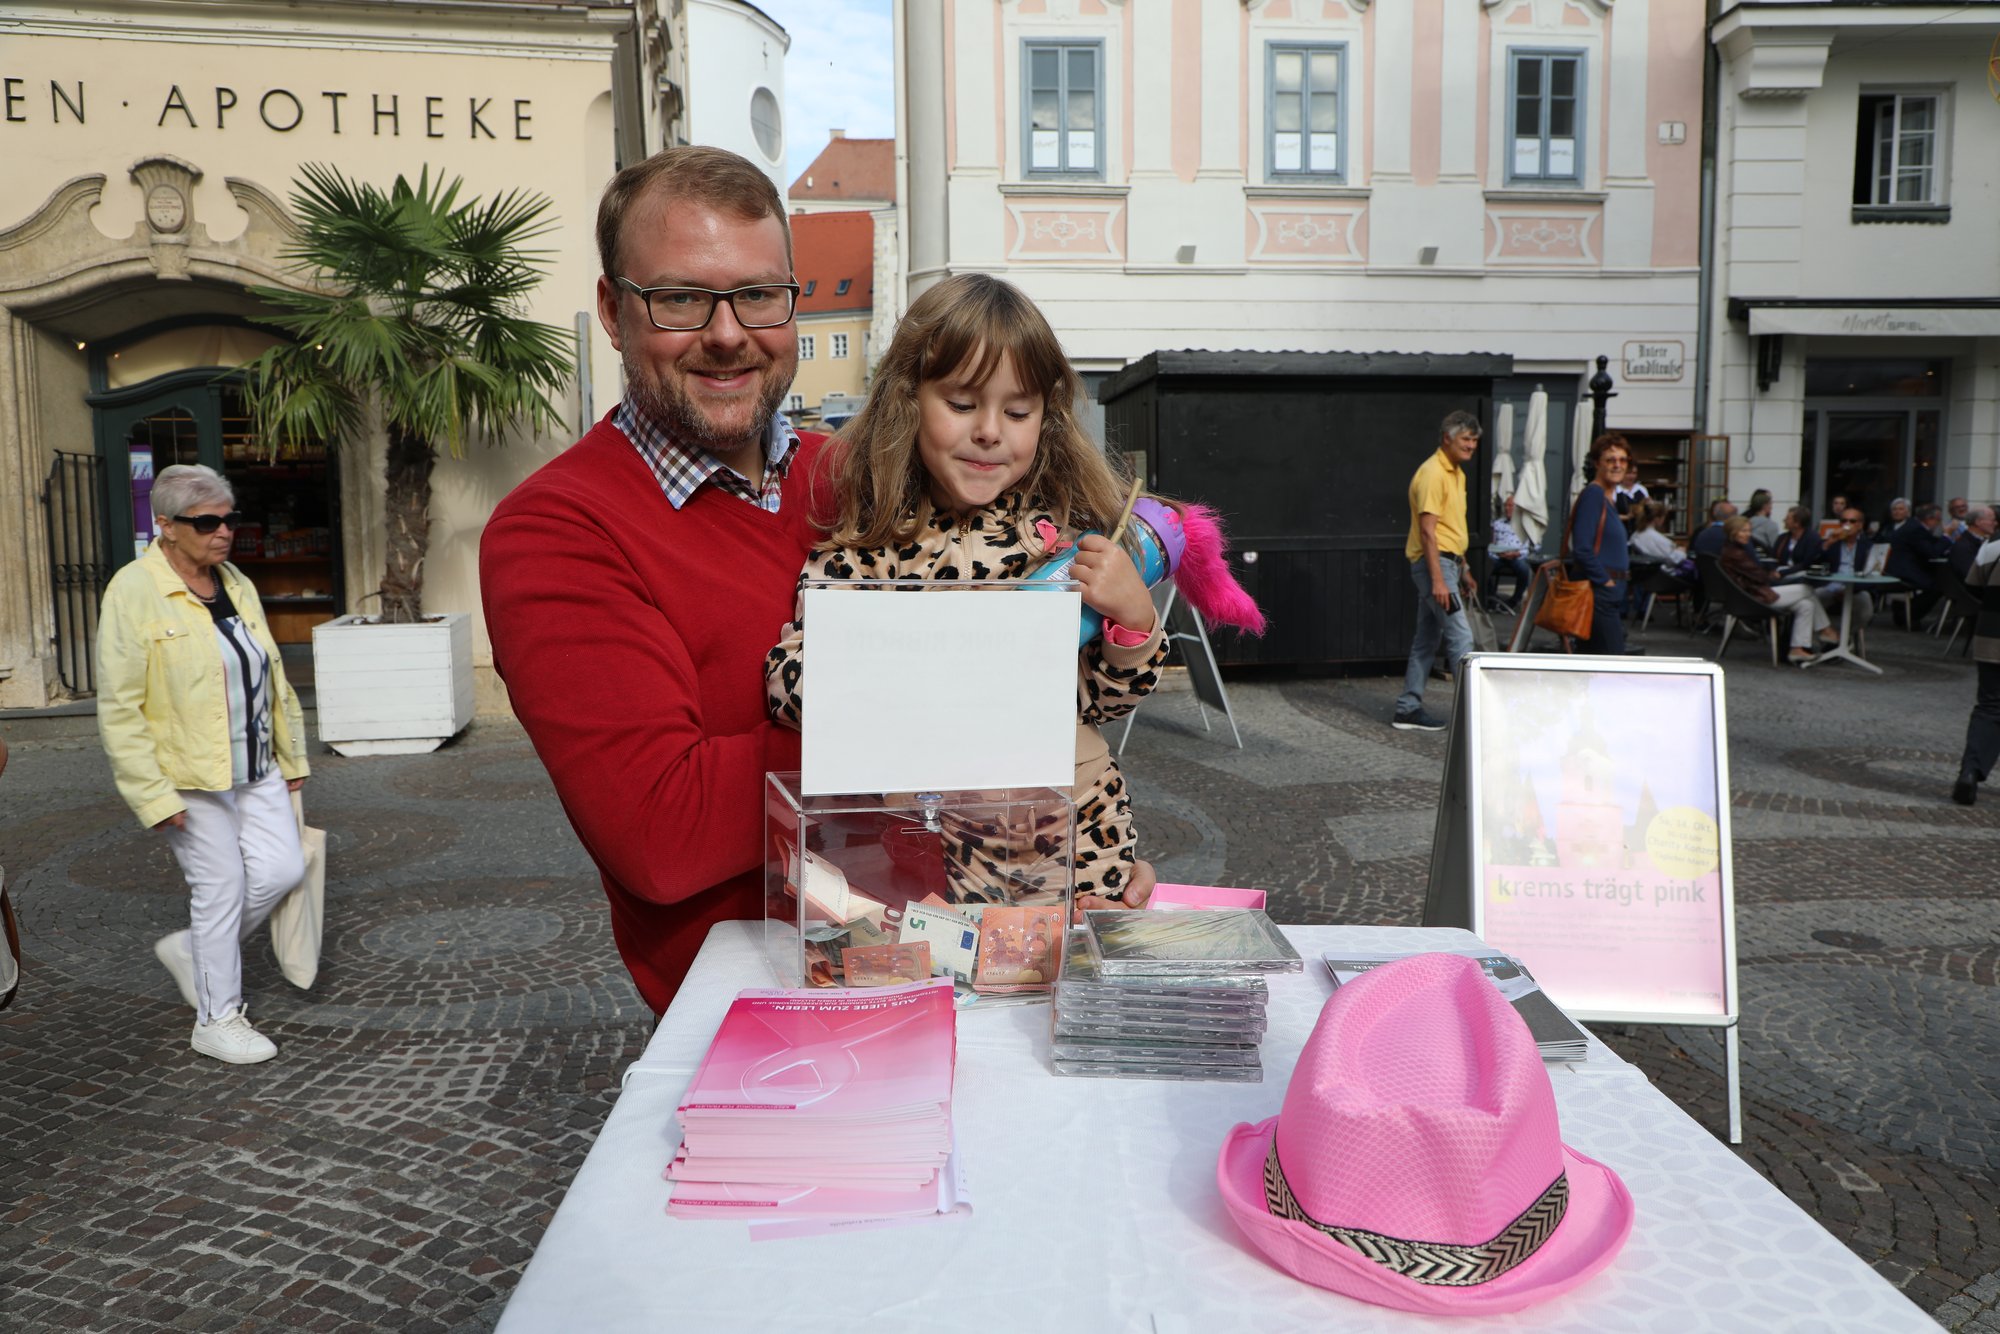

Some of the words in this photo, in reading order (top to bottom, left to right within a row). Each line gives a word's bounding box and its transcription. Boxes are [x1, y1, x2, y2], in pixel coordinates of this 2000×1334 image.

[4, 77, 87, 124] EN
[158, 84, 535, 141] APOTHEKE
[1498, 873, 1575, 898] krems
[1583, 877, 1645, 907] trägt
[1653, 879, 1707, 908] pink
[910, 917, 926, 931] 5
[891, 998, 918, 1007] AUS
